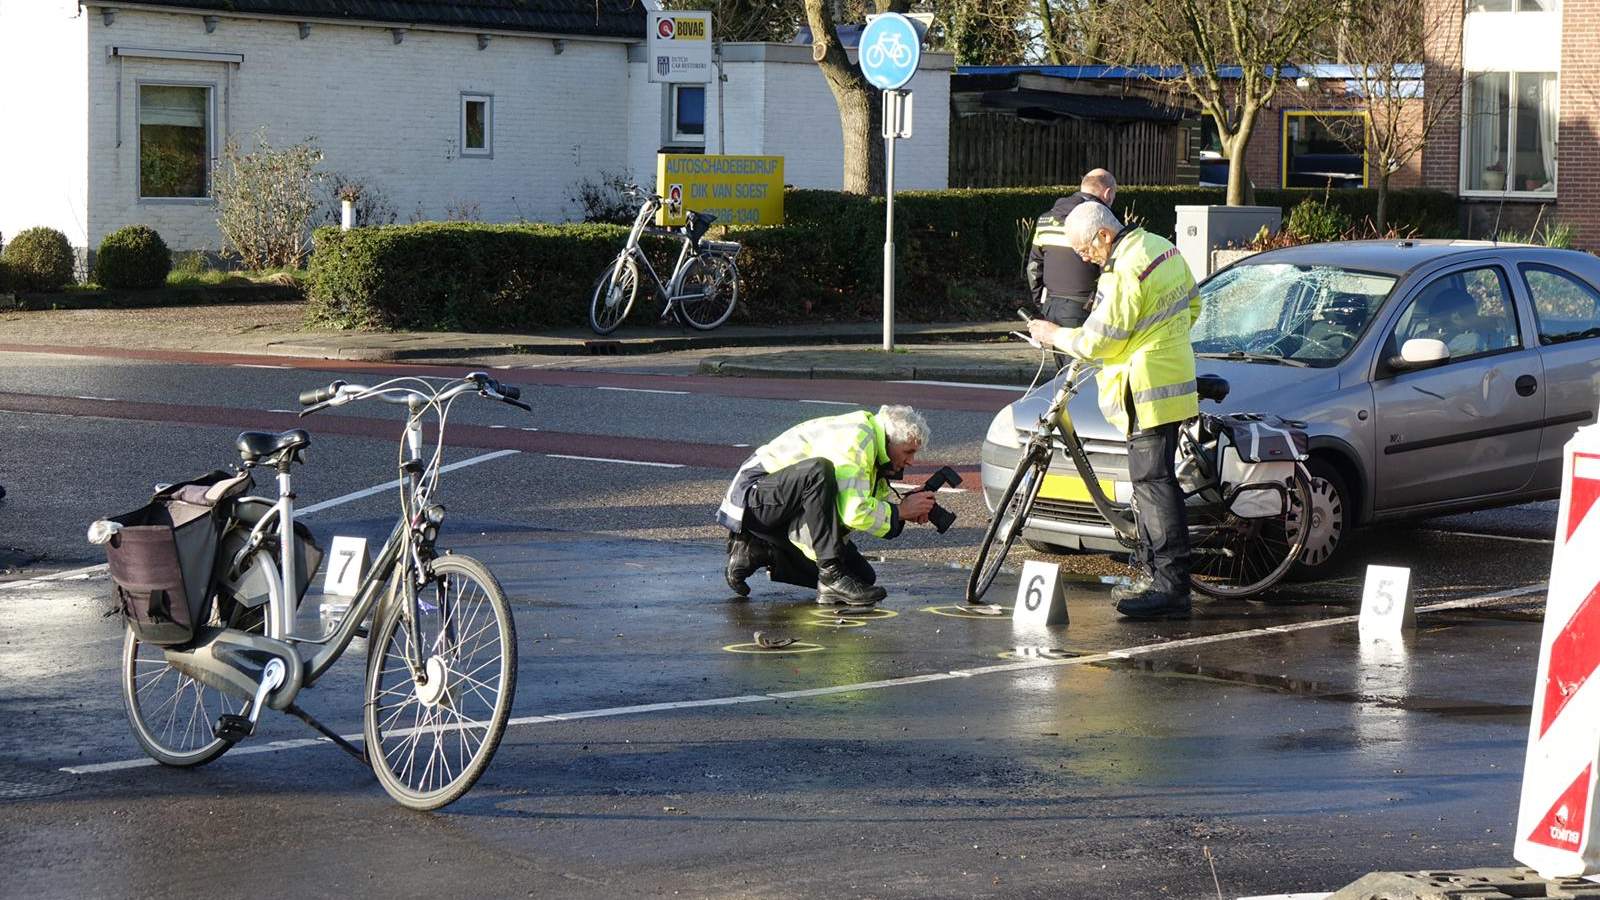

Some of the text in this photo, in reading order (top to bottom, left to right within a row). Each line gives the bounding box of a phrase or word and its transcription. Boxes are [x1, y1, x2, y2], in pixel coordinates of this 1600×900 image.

[677, 22, 704, 37] BOVAG
[667, 159, 778, 175] AUTOSCHADEBEDRIJF
[691, 184, 769, 199] DIK VAN SOEST
[337, 550, 357, 584] 7
[1024, 574, 1045, 612] 6
[1372, 579, 1394, 616] 5
